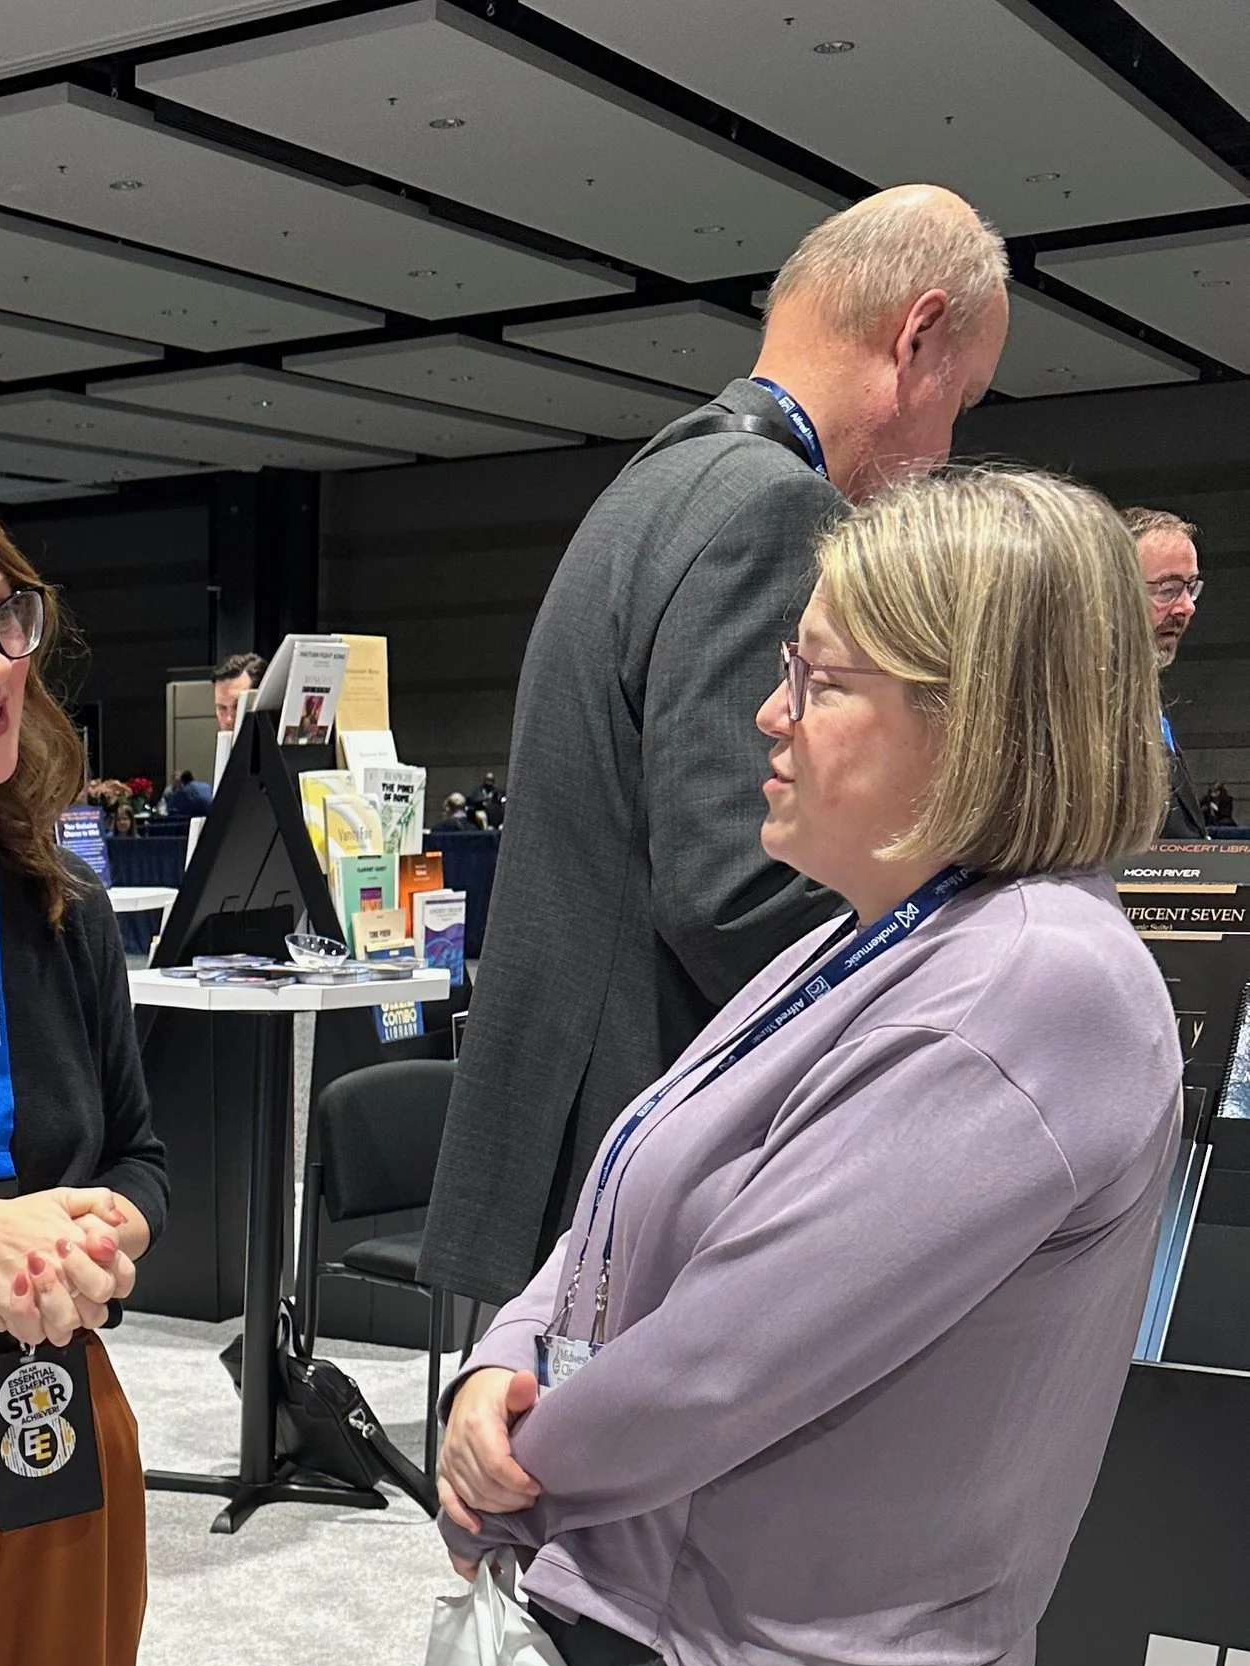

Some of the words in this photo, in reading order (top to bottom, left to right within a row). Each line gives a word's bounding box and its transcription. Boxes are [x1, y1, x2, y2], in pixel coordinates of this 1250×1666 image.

[381, 783, 395, 792] THE
[1159, 844, 1218, 853] CONCERT
[1124, 868, 1162, 878] MOON
[1162, 869, 1201, 878] RIVER
[1190, 908, 1246, 922] SEVEN
[847, 921, 899, 969] makemusic
[382, 1012, 417, 1027] COMBO
[774, 998, 805, 1026] Alfred
[384, 1021, 419, 1042] LIBRARY
[7, 1366, 55, 1389] ESSENTIAL
[9, 1374, 57, 1397] ELEMENTS
[21, 1405, 59, 1425] ACHIEVER!
